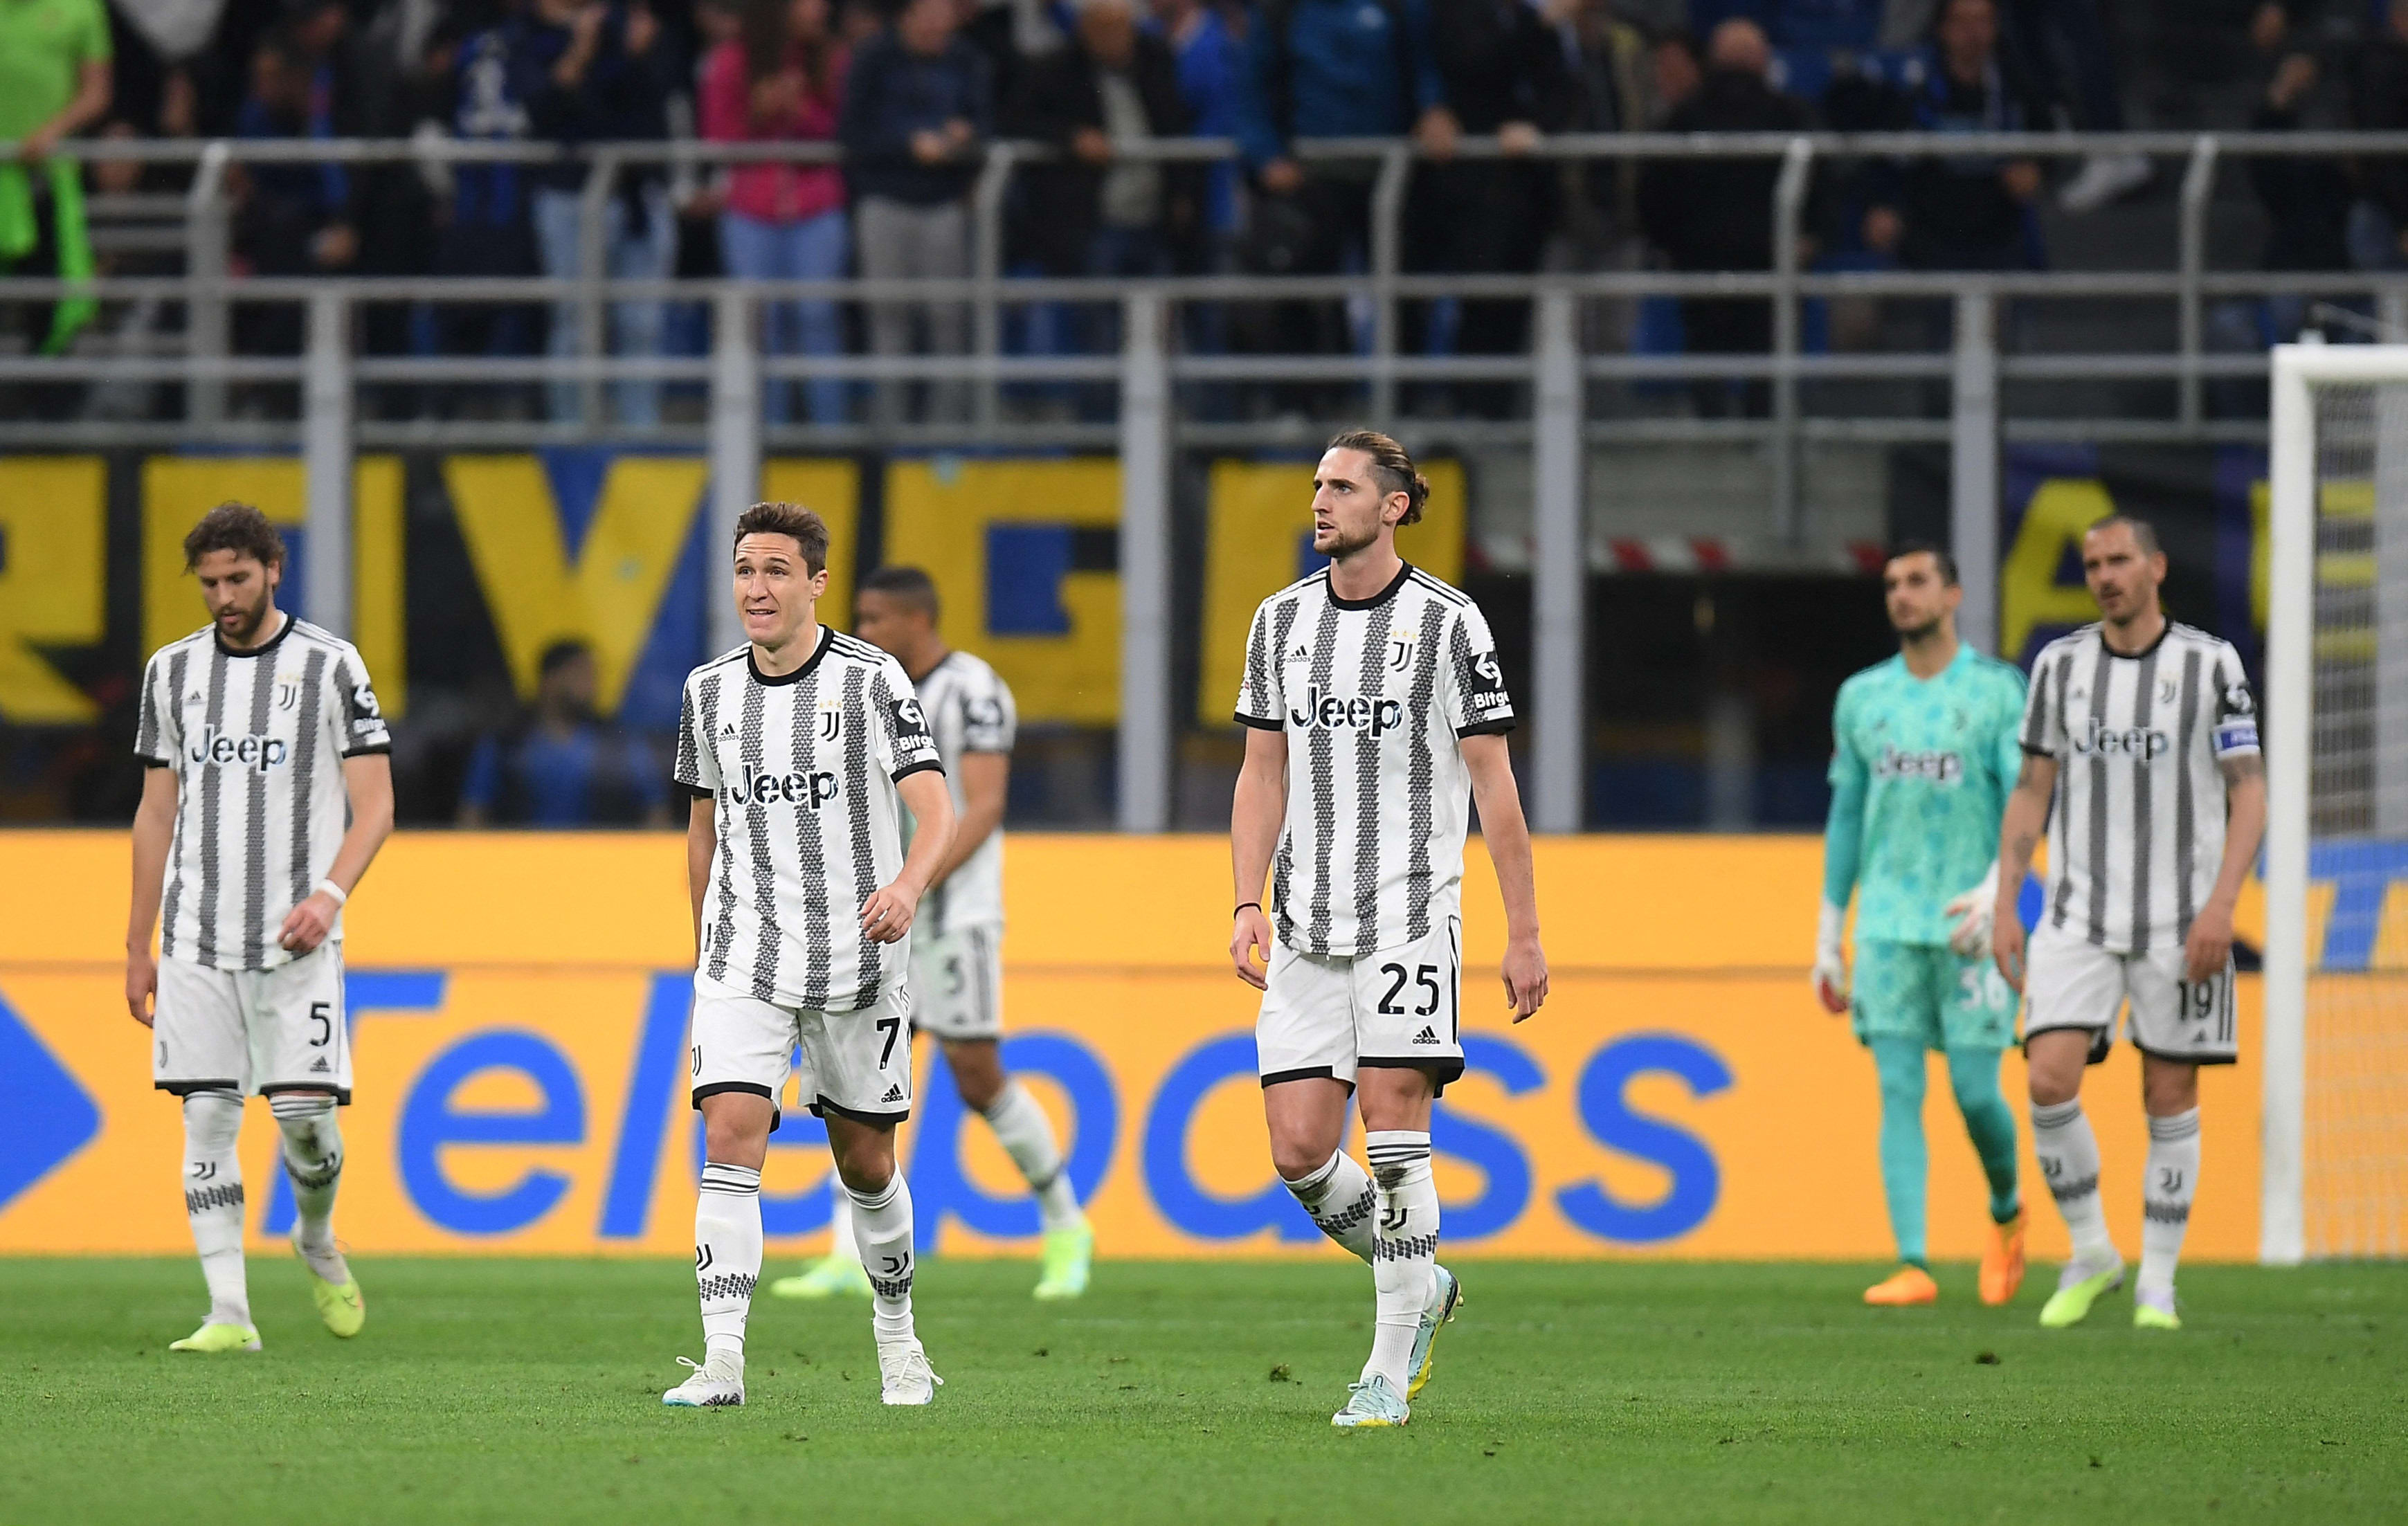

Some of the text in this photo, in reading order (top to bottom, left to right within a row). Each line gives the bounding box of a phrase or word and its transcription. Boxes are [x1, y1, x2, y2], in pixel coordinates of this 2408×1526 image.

[1290, 686, 1403, 738] Jeep
[190, 725, 287, 772] Jeep
[1875, 742, 1963, 781] Jeep
[2074, 718, 2169, 761] Jeep
[731, 763, 840, 810] Jeep
[1377, 962, 1440, 1017] 25
[2177, 979, 2214, 1020] 19
[309, 1001, 331, 1047] 5
[876, 1016, 901, 1071] 7
[1412, 1037, 1441, 1045] adidas
